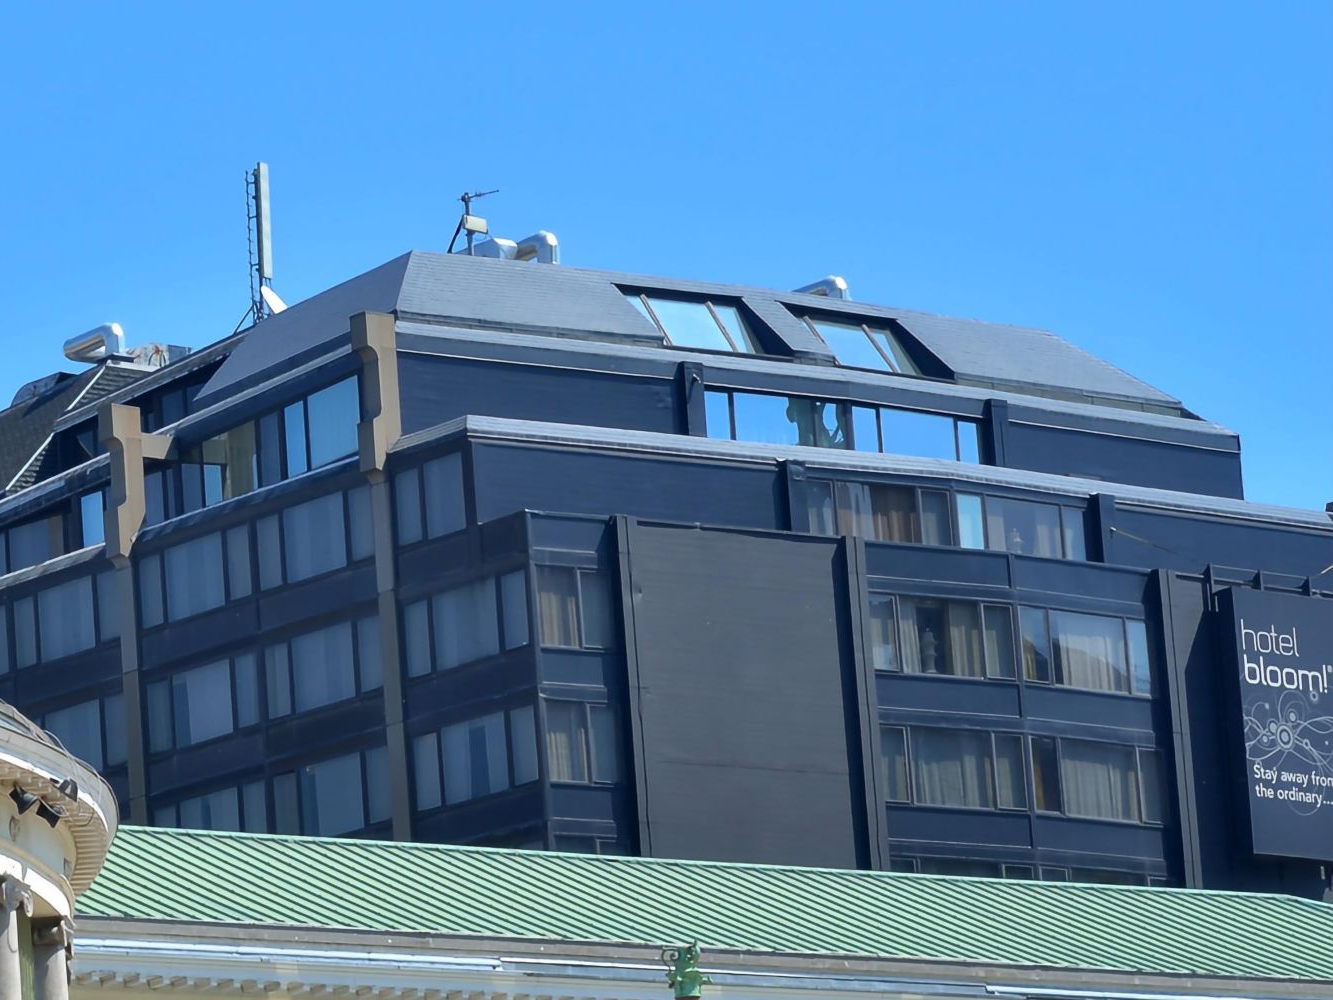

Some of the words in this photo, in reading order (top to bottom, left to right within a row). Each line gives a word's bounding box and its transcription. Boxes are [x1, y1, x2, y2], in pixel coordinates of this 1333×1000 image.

[1240, 618, 1300, 657] hotel
[1243, 653, 1328, 694] bloom!
[1253, 764, 1278, 784] Stay
[1280, 771, 1309, 788] away
[1255, 782, 1275, 799] the
